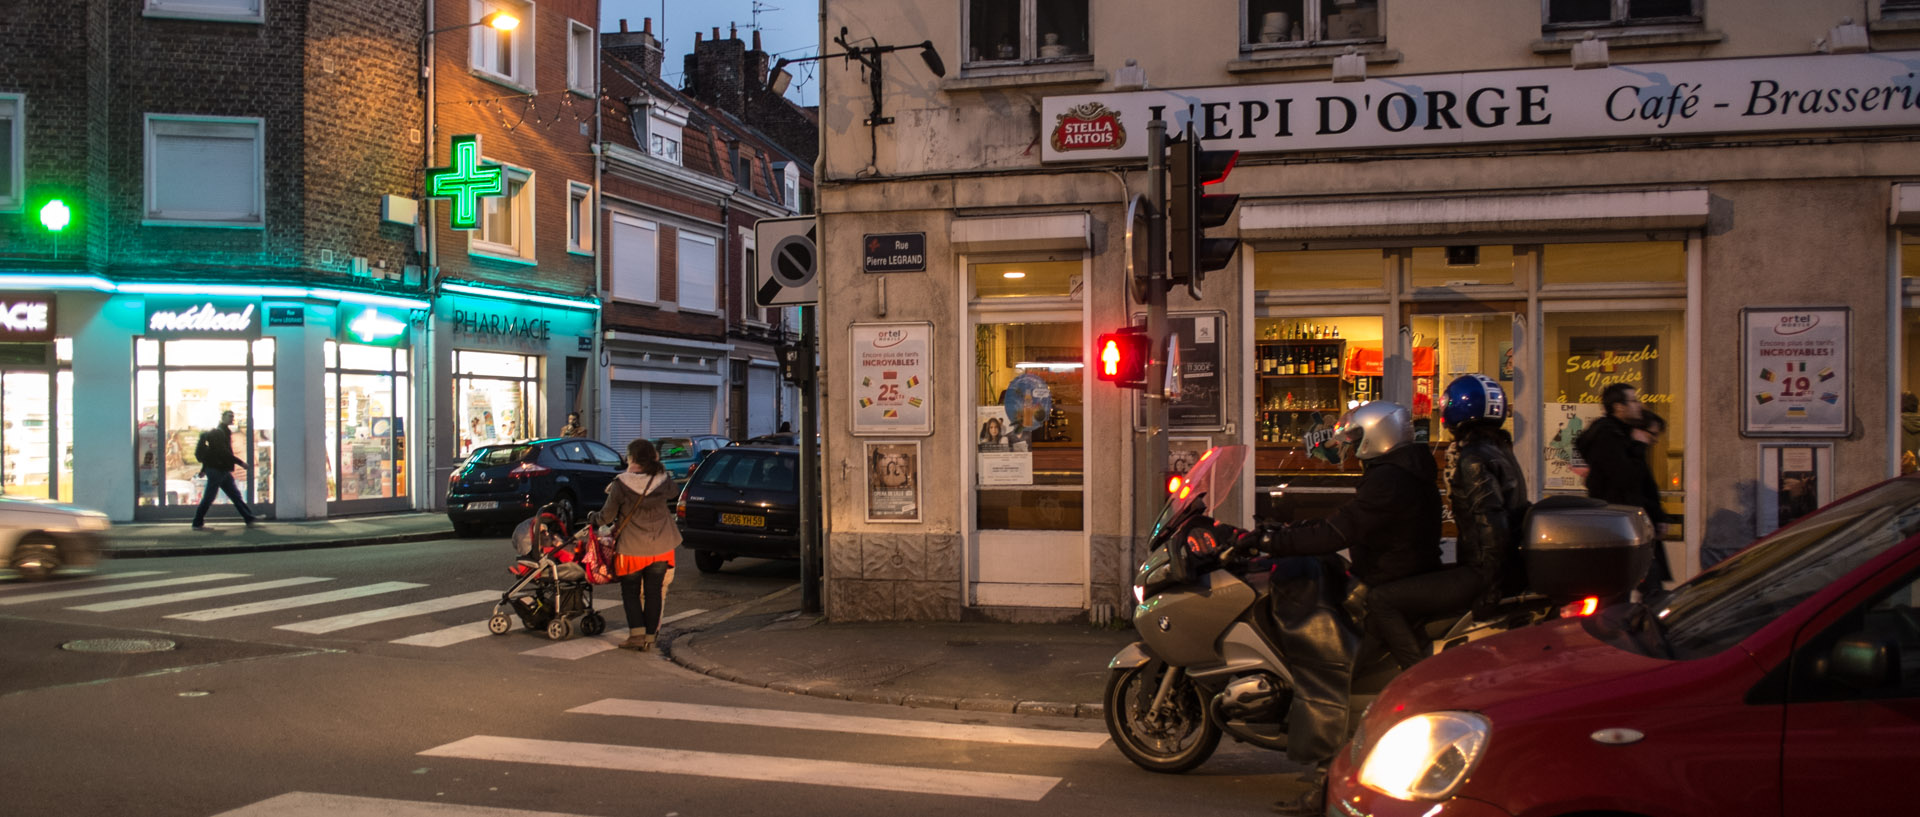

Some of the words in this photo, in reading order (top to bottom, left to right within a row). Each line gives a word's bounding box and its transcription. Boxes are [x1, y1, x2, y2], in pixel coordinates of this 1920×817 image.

[1605, 82, 1703, 129] Café
[1148, 98, 1293, 146] L'EPI
[1315, 85, 1553, 136] D'ORGE
[1065, 121, 1112, 133] STELLA
[1064, 132, 1113, 144] ARTOIS
[895, 240, 909, 250] Rue
[866, 256, 887, 266] Pierre
[888, 254, 923, 265] LEGRAND
[150, 303, 255, 331] médical
[1780, 314, 1811, 323] ortel
[454, 309, 552, 341] PHARMACIE
[1565, 344, 1659, 373] Sandwichs
[1760, 348, 1828, 356] INCROYABLES
[1584, 368, 1643, 388] Variés
[877, 384, 899, 401] 25
[1780, 376, 1810, 396] 19
[1557, 390, 1568, 403] à
[1579, 391, 1605, 404] tou
[722, 513, 741, 524] 5806
[742, 514, 752, 525] YH
[753, 516, 763, 526] 59
